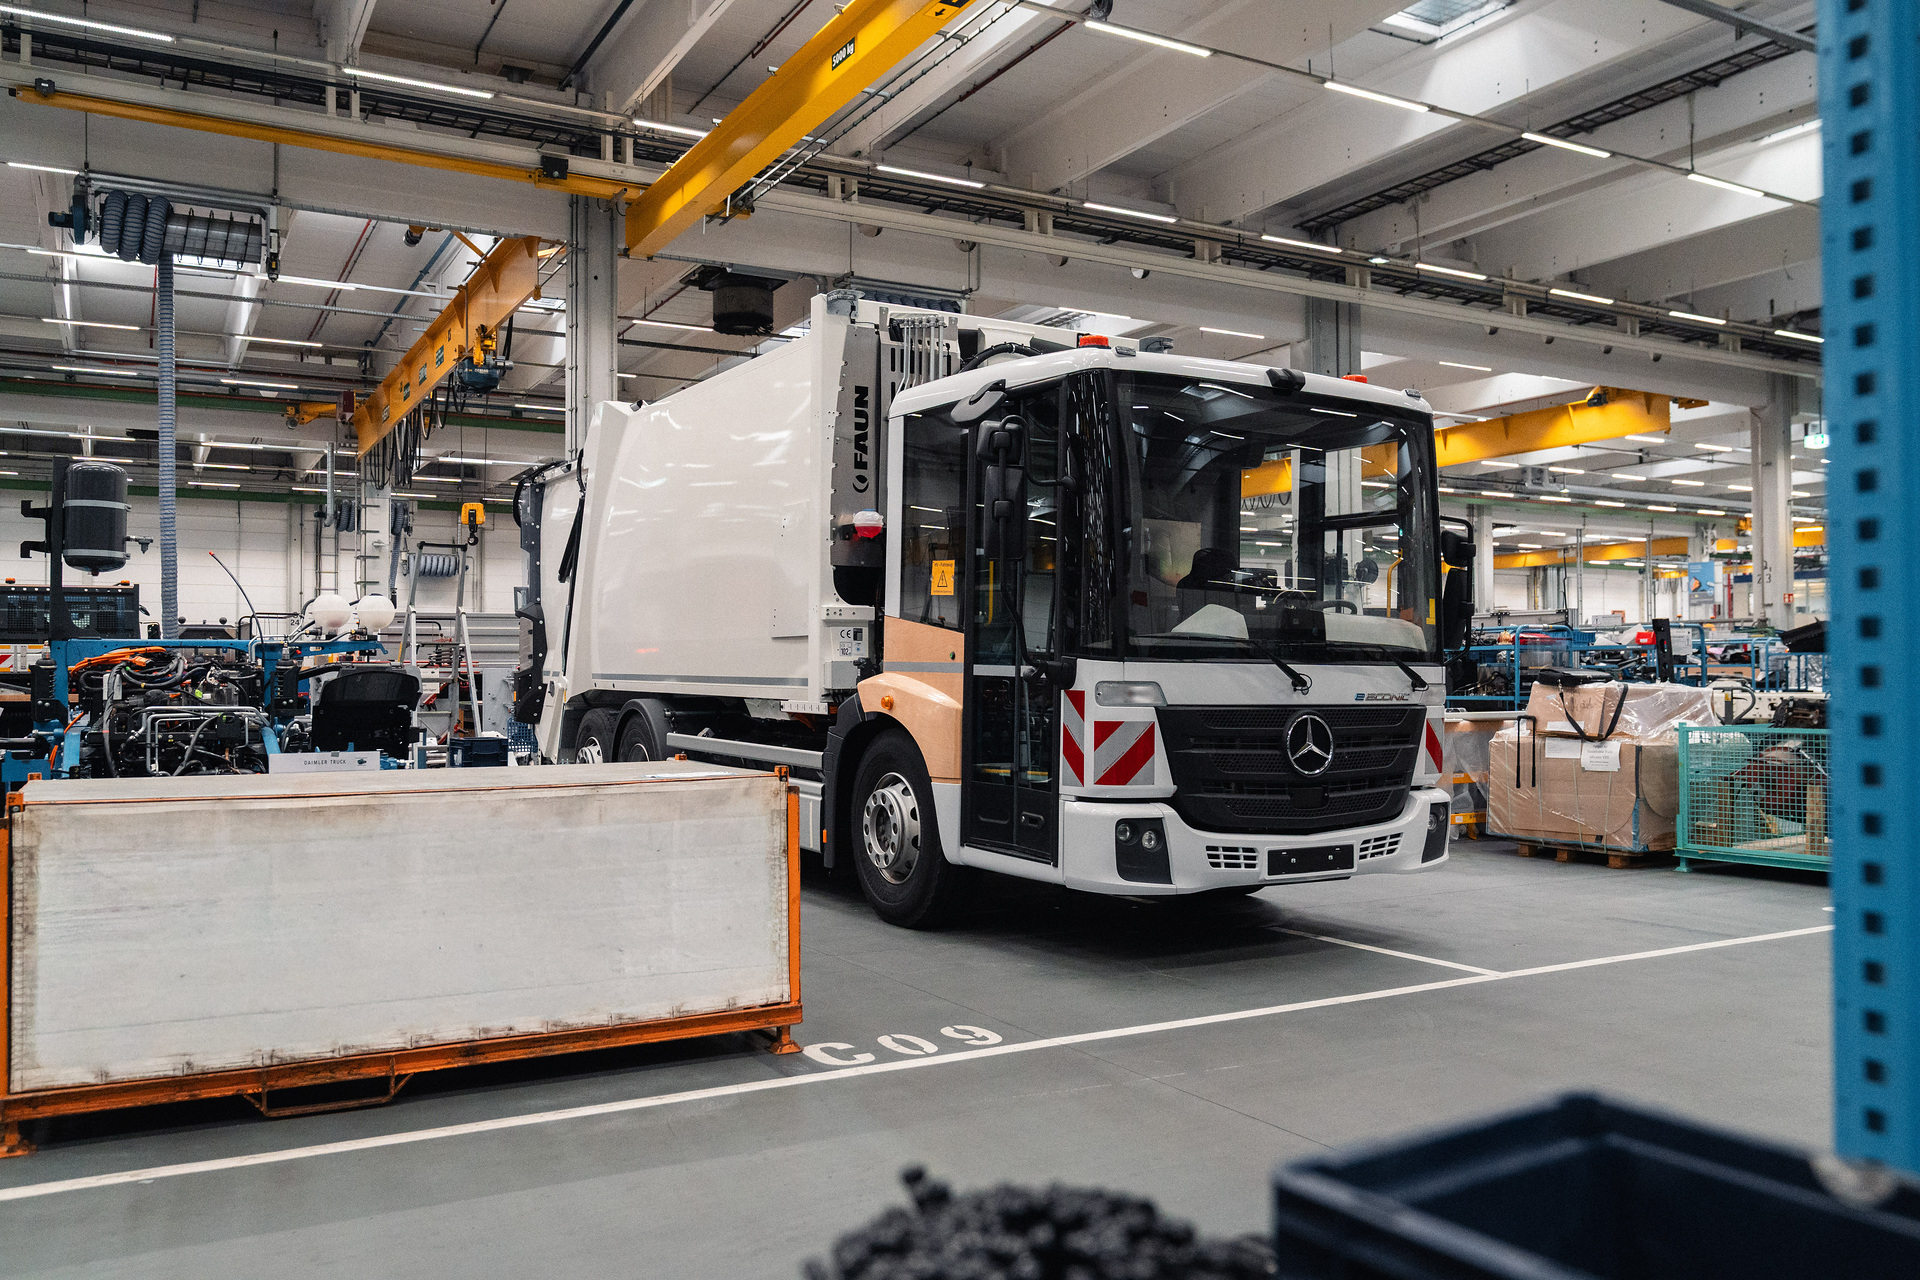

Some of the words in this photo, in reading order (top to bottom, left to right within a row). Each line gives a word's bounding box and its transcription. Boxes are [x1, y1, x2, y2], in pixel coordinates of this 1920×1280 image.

[832, 47, 846, 67] 5000
[846, 43, 854, 55] kg
[854, 385, 869, 470] FAUN
[803, 1025, 1003, 1066] C09
